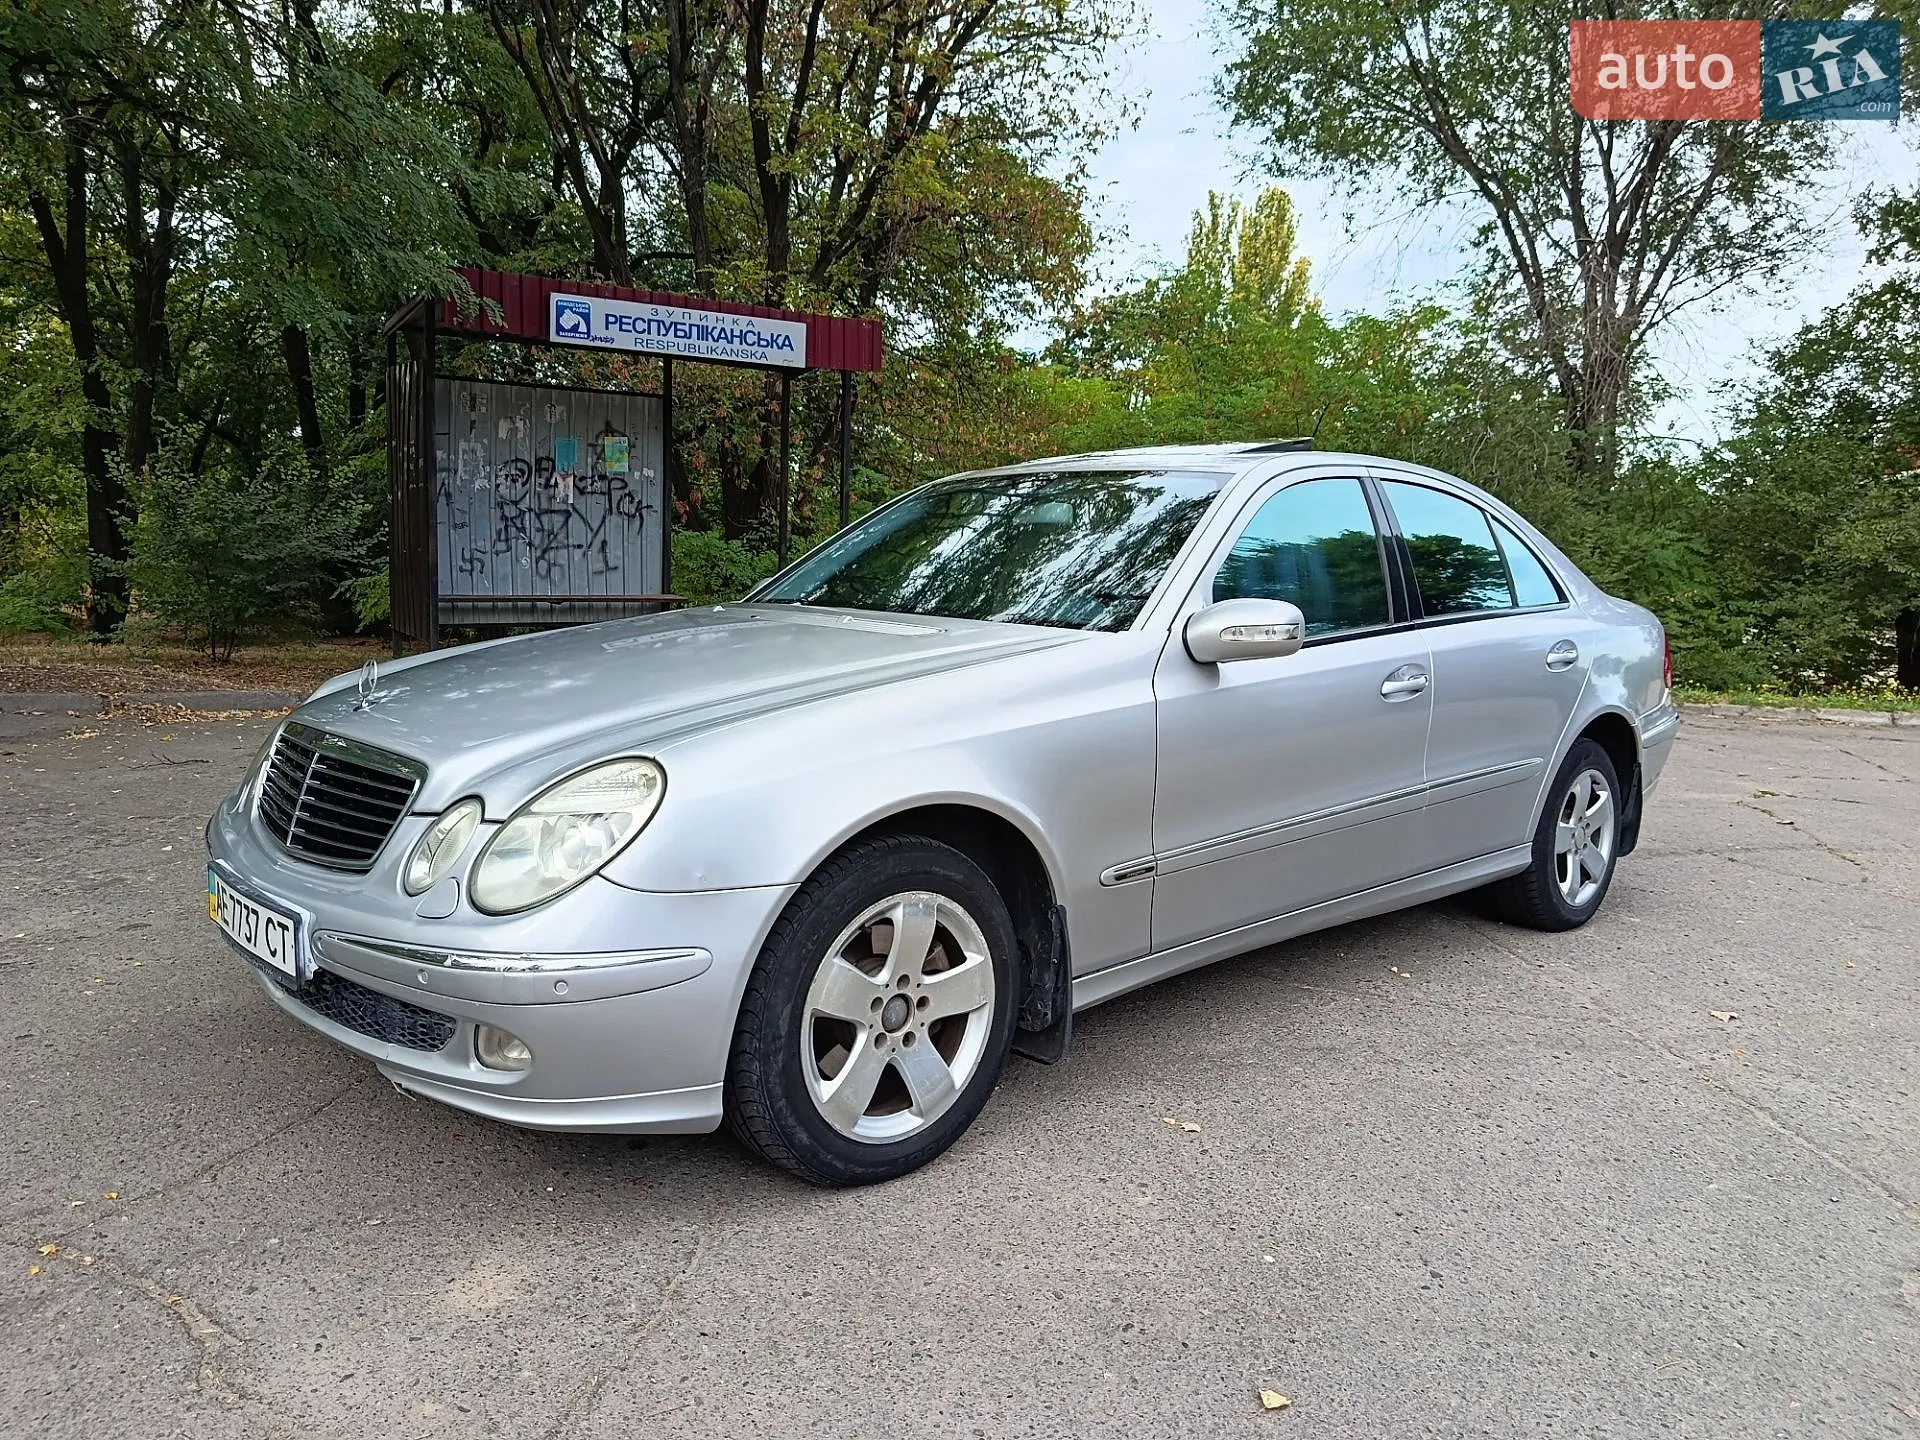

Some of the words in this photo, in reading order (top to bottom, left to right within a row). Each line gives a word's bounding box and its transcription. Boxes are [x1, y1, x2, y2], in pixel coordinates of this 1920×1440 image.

[650, 307, 756, 328] ЗУПИНКА
[604, 313, 795, 352] РЕСПУБЛІКАНСЬКА
[634, 337, 769, 362] RESPUBLIKANSKA
